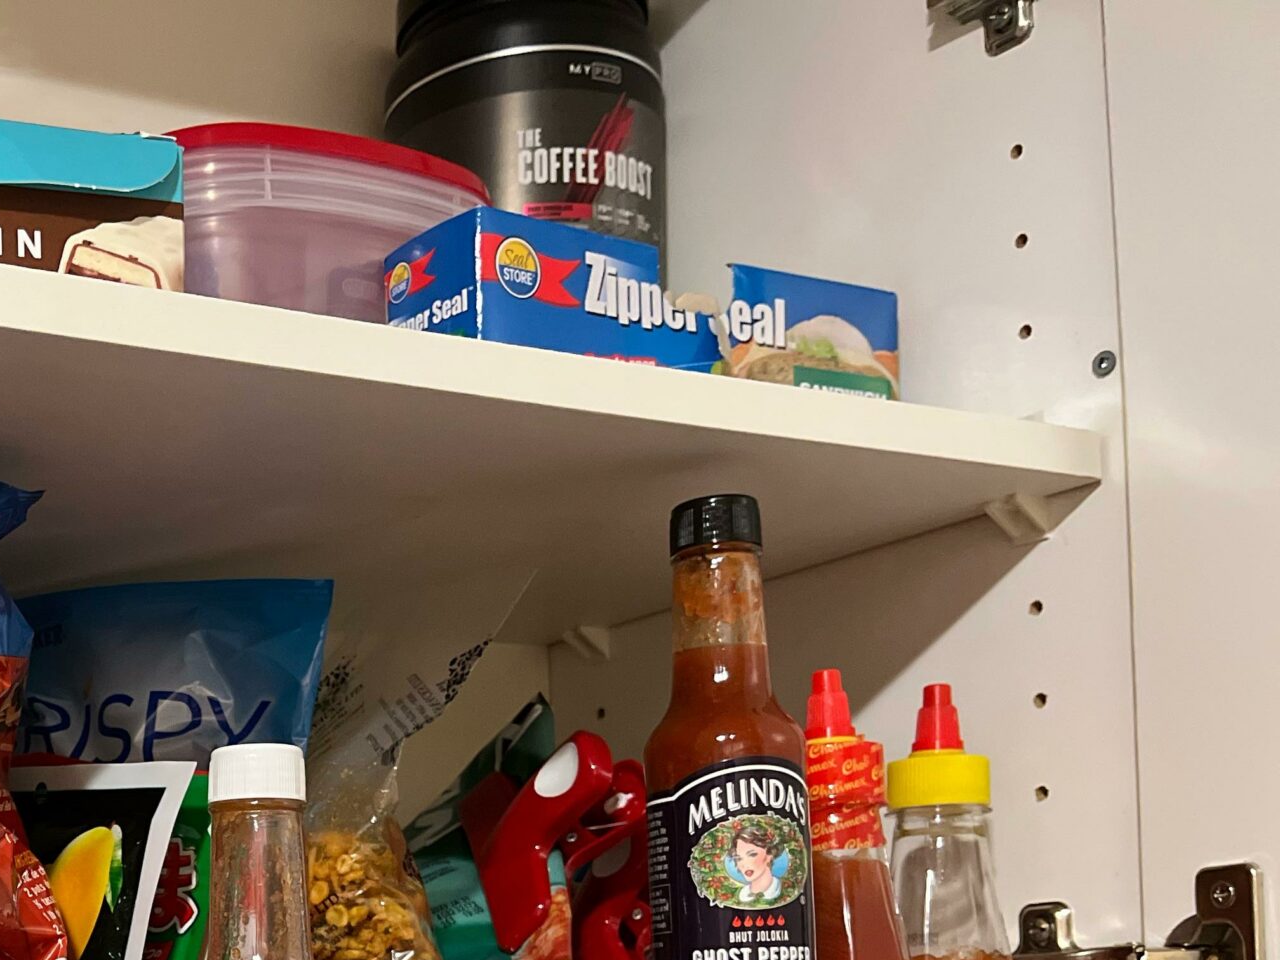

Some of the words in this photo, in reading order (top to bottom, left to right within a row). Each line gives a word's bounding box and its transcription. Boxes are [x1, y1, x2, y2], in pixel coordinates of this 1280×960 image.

[517, 128, 542, 148] THE
[518, 147, 600, 185] COFFEE
[604, 151, 652, 200] BOOST
[503, 269, 533, 286] STORE
[432, 288, 469, 324] Seal
[24, 690, 272, 764] RISPY
[688, 778, 807, 836] MELINDA'S
[729, 930, 753, 943] BHUT
[756, 930, 789, 942] JOLOKIA
